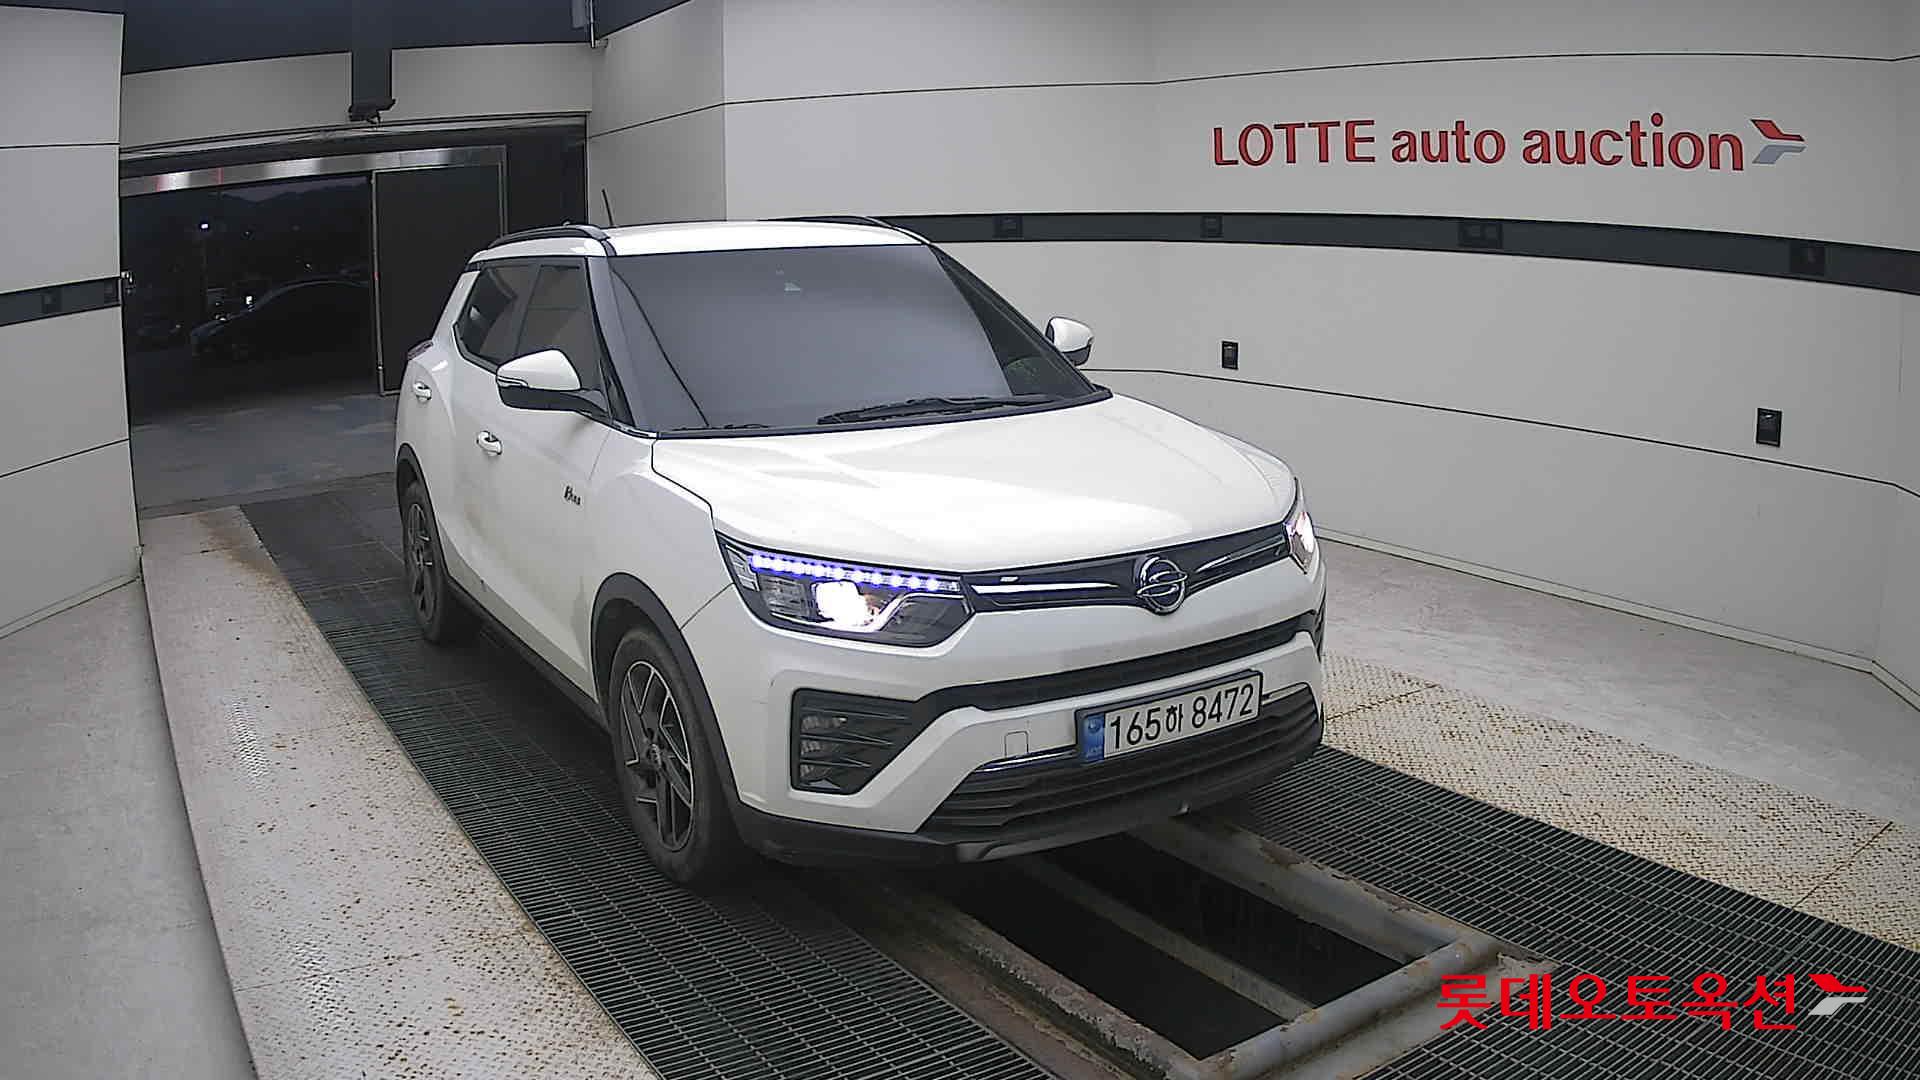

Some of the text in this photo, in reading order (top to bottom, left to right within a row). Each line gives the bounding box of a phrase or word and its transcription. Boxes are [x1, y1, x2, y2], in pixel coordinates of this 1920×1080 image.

[1213, 112, 1745, 171] LOTTE auto auction
[1110, 683, 1254, 749] 165하 8472
